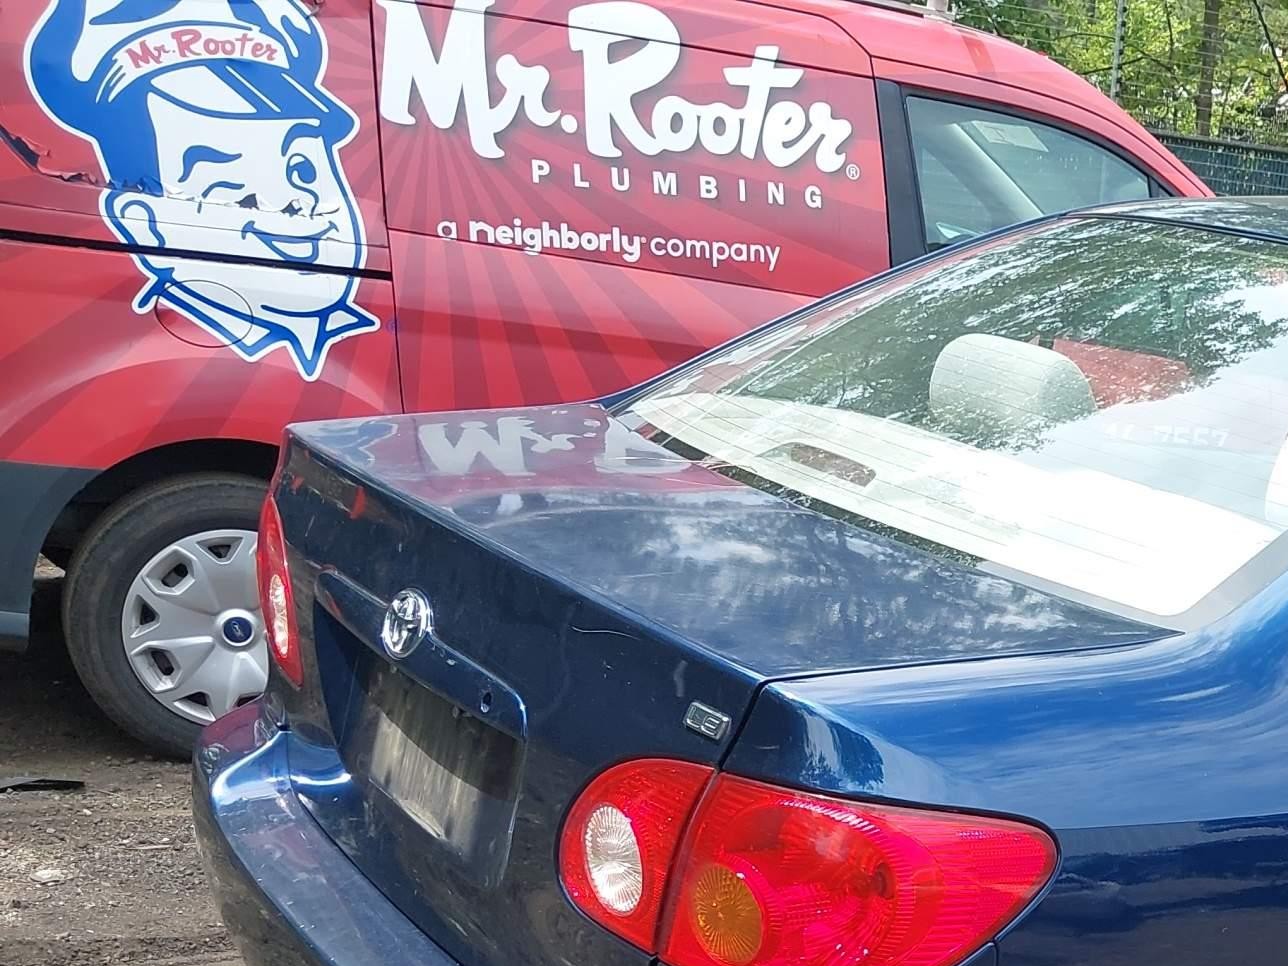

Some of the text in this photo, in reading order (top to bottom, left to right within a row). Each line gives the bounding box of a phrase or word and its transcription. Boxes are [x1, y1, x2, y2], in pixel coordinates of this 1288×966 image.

[126, 28, 277, 69] Mr. Rooter
[379, 0, 579, 159] Mr.
[531, 158, 823, 209] PLUMBING
[436, 217, 781, 272] a neighborly company
[686, 704, 722, 737] LE
